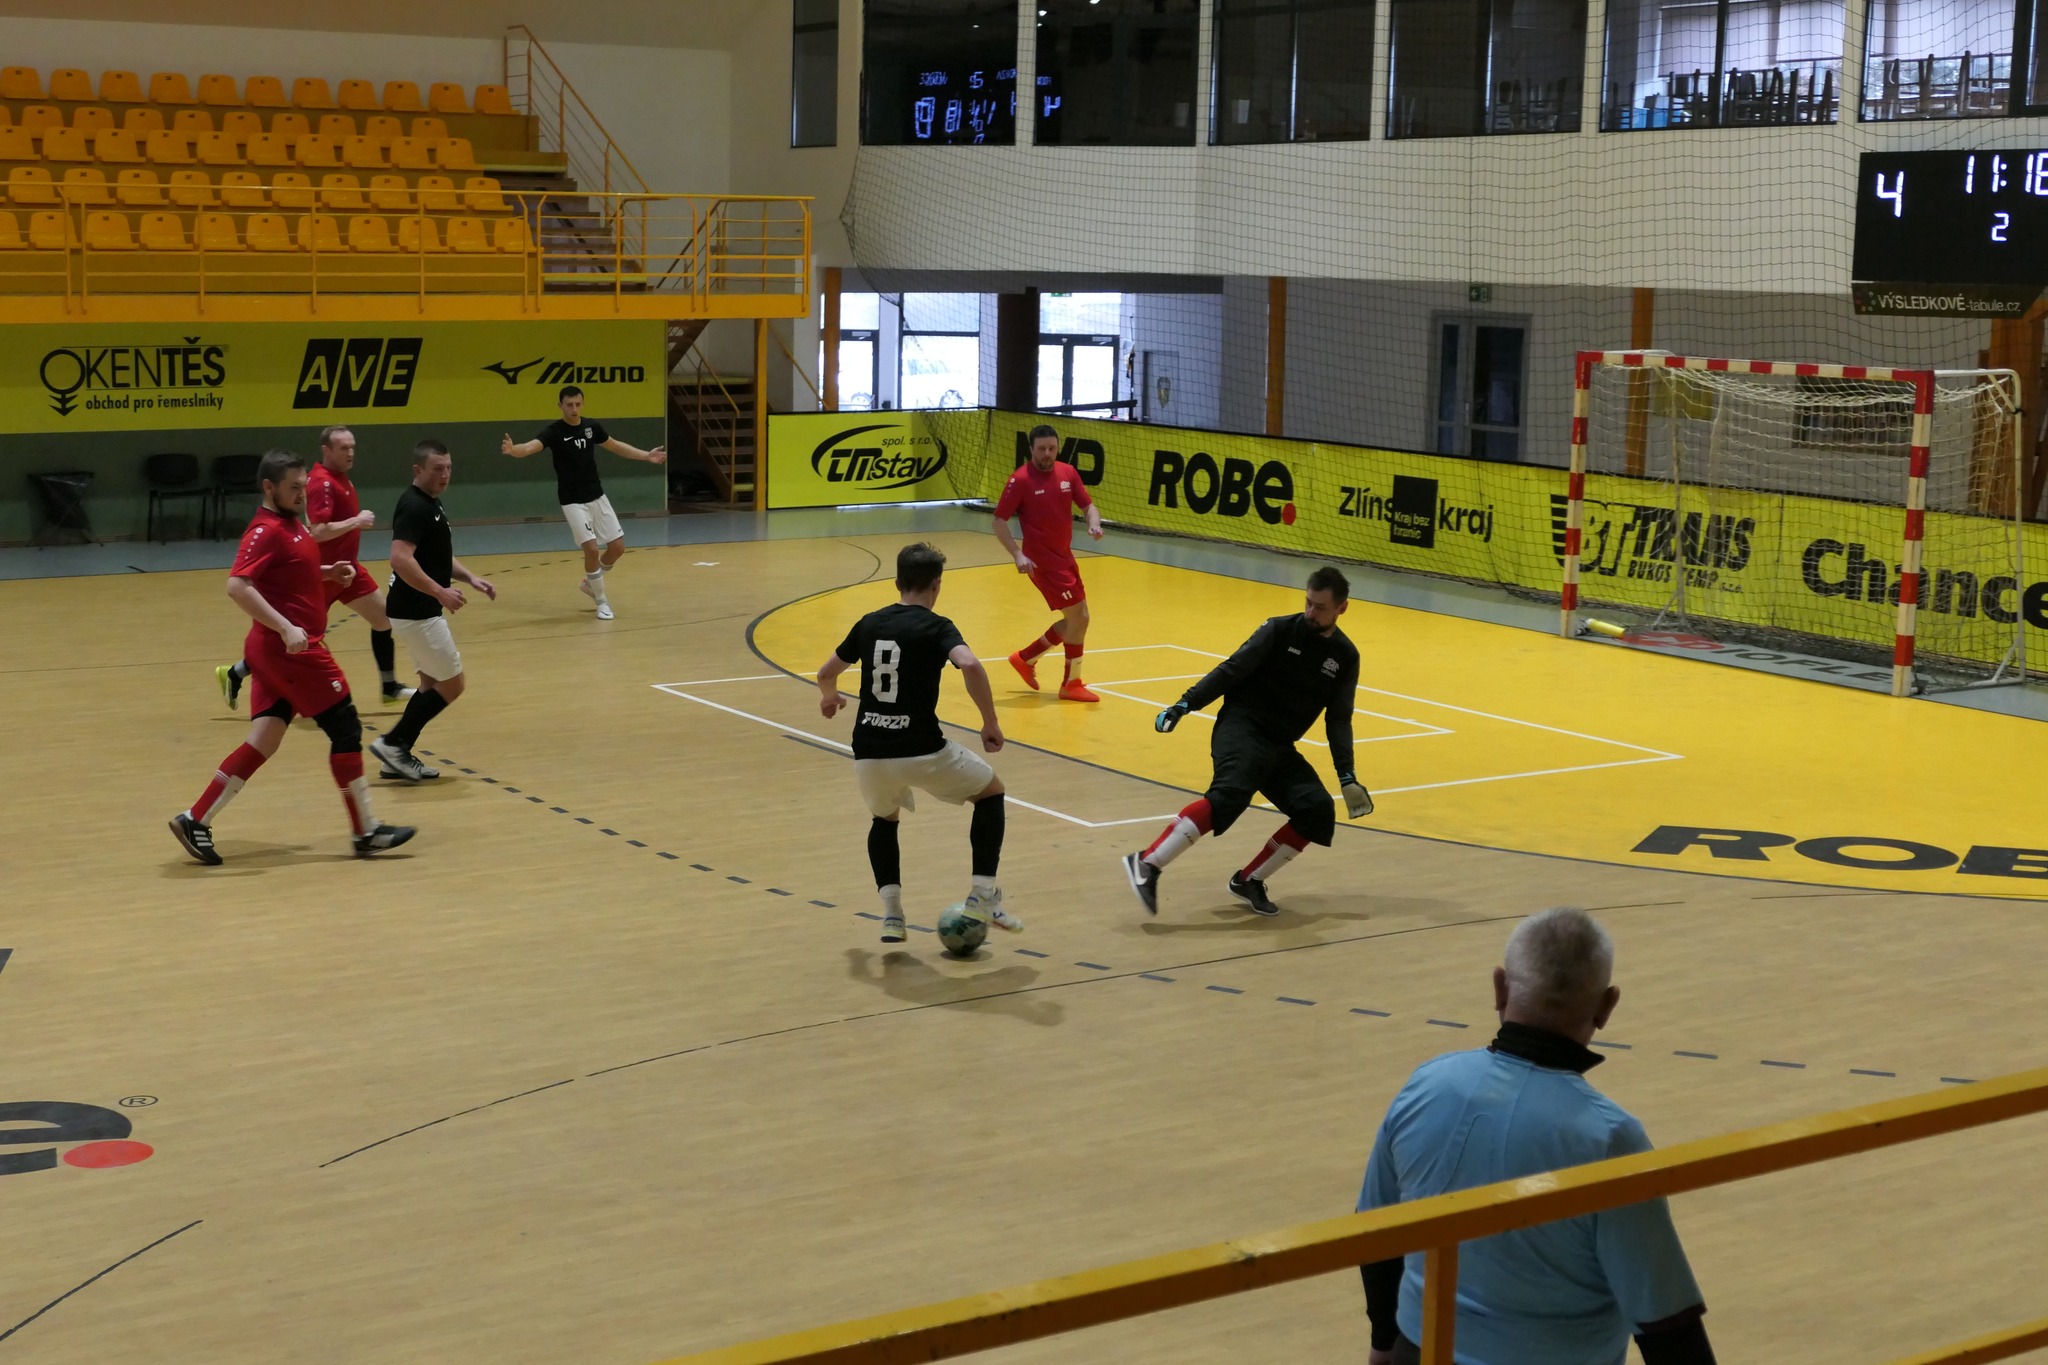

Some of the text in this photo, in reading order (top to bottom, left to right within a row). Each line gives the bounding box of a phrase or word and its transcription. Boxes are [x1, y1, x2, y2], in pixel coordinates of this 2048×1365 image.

[1876, 171, 1904, 218] 4
[1991, 212, 2010, 242] 2
[39, 336, 226, 394] OKENTĚS
[300, 353, 415, 393] AVE
[86, 393, 224, 413] obchod pro řemeslníky
[574, 438, 588, 450] 47
[881, 436, 905, 448] spol.
[909, 437, 915, 445] s
[1413, 512, 1431, 526] bez
[1438, 497, 1495, 544] kraj
[871, 639, 902, 704] 8
[861, 711, 911, 730] FORZA
